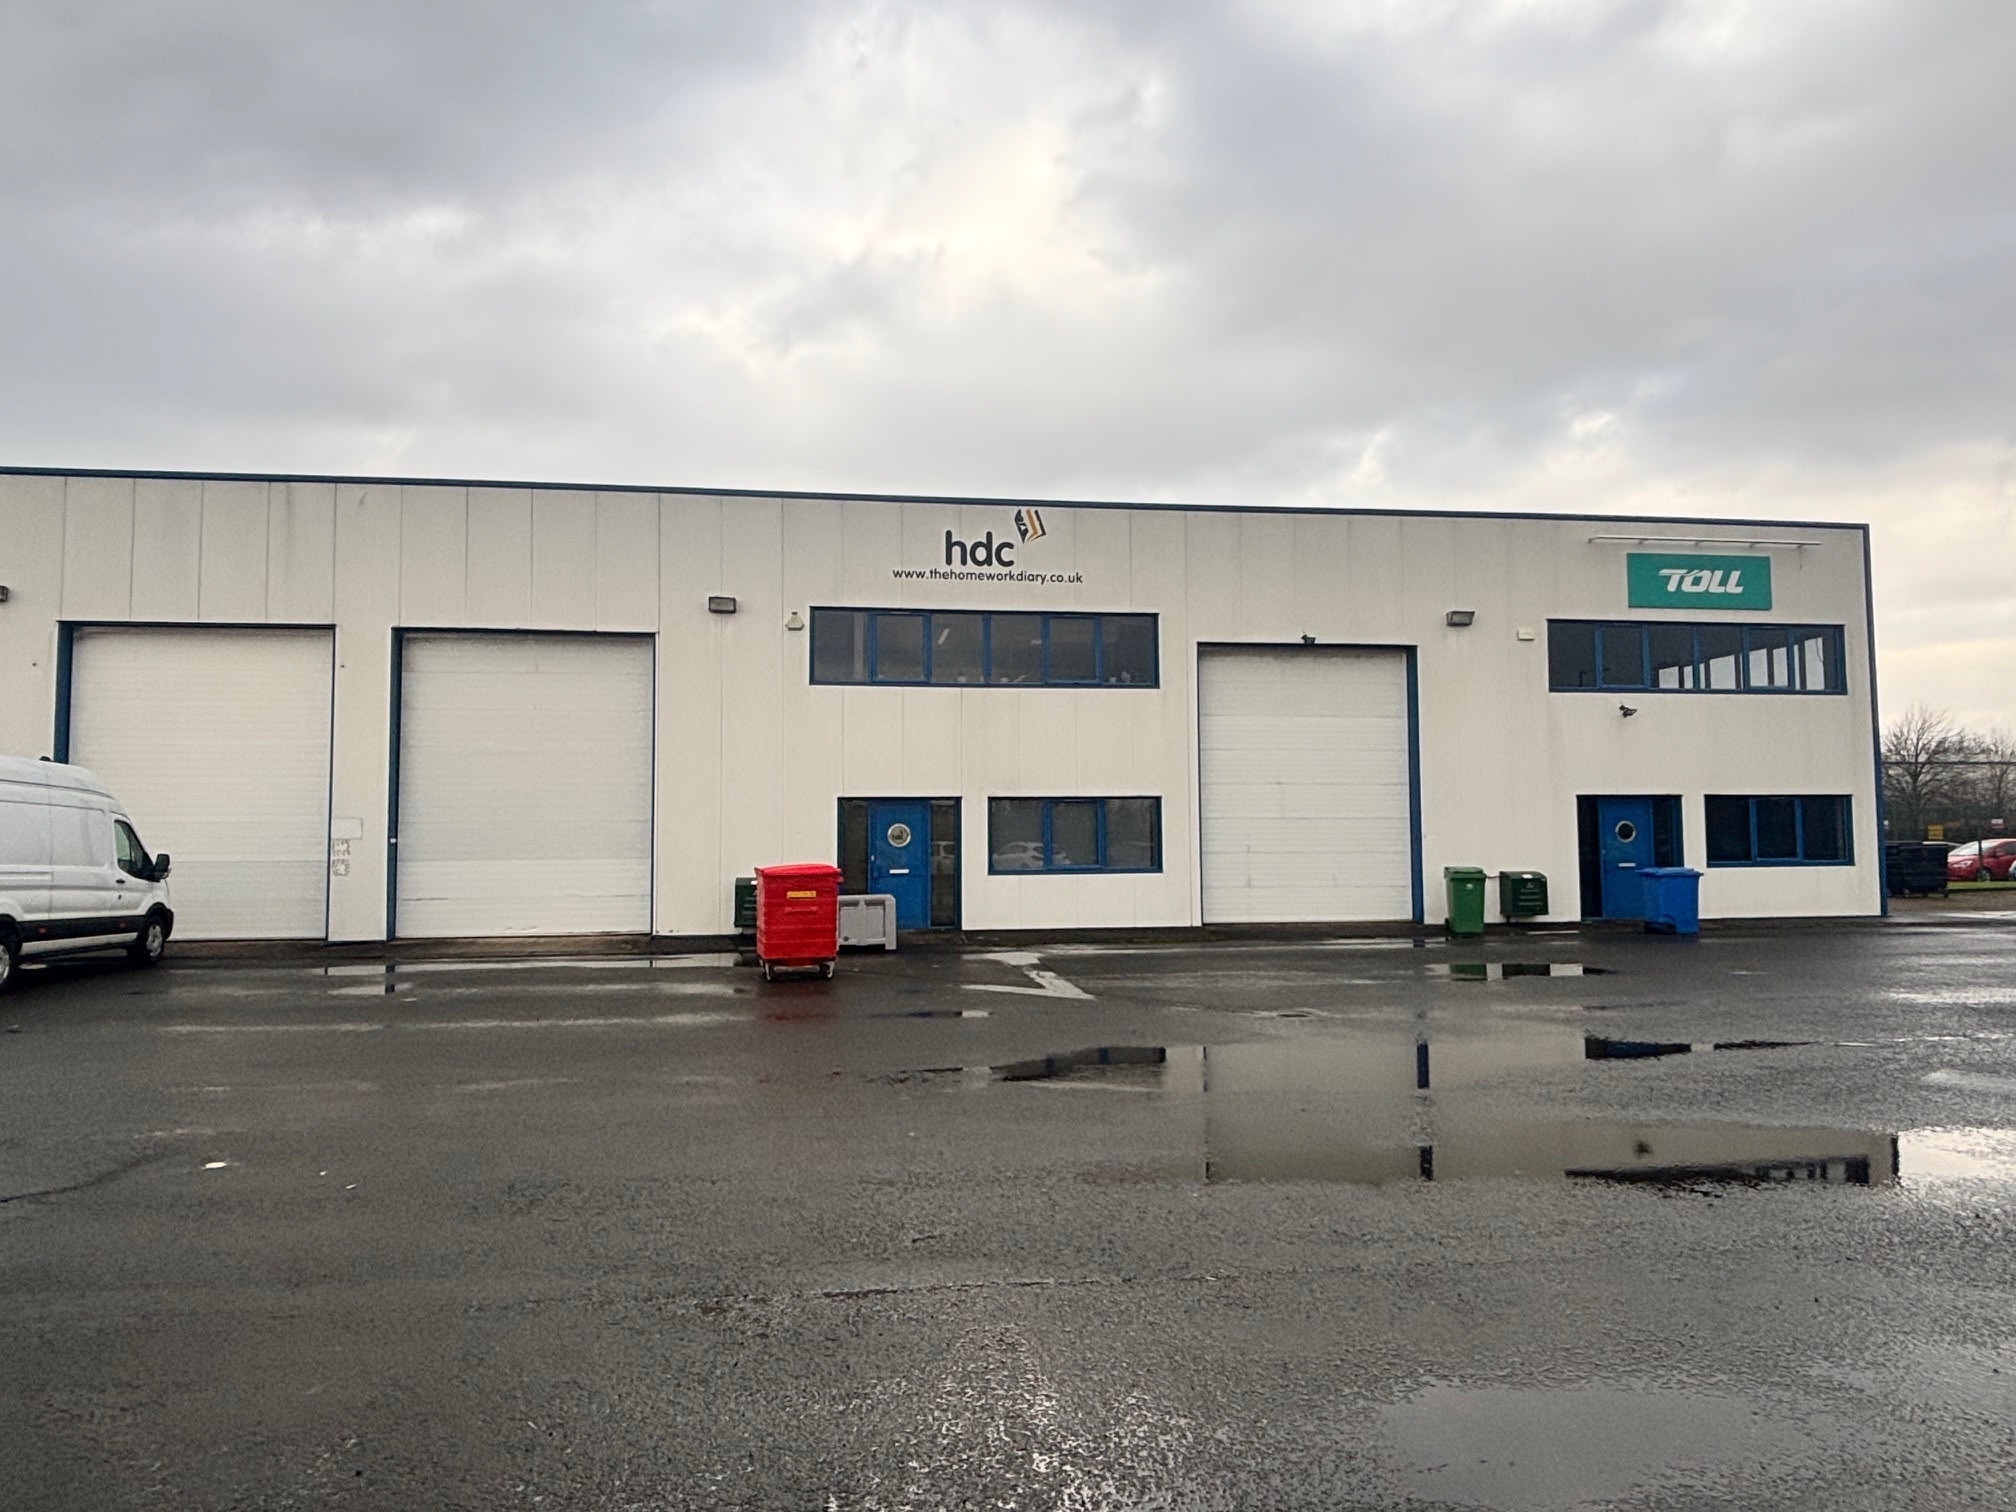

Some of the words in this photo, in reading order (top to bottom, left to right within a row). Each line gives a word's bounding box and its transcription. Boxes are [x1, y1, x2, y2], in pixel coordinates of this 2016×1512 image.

[945, 529, 1015, 567] hdc
[893, 568, 1083, 585] www.thehomeworkdiary.co.uk
[1658, 568, 1744, 594] TOLL
